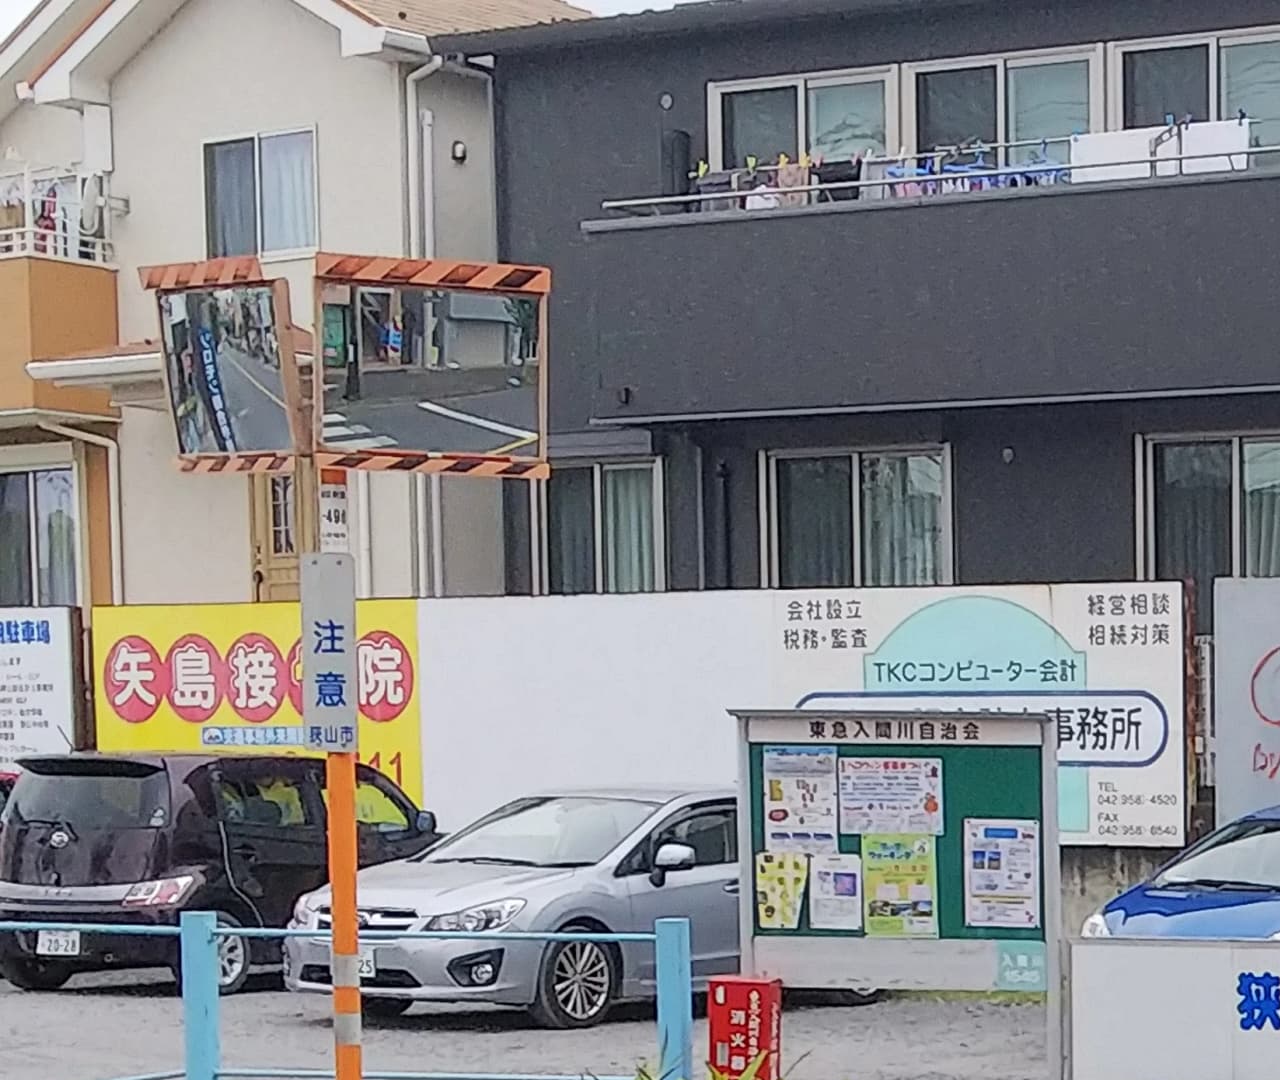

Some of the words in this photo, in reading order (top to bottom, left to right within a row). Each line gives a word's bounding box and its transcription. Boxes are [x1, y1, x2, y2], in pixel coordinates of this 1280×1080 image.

[787, 600, 862, 621] 会社設立
[1087, 593, 1170, 616] 経営相談
[1088, 624, 1170, 646] 相続対策
[313, 620, 346, 707] 注意
[873, 658, 1077, 684] TKCコンピューター会計
[113, 641, 404, 709] 矢島接院
[808, 720, 980, 740] 東急入間川自治会
[1097, 781, 1119, 792] TEL
[1097, 812, 1119, 823] FAX
